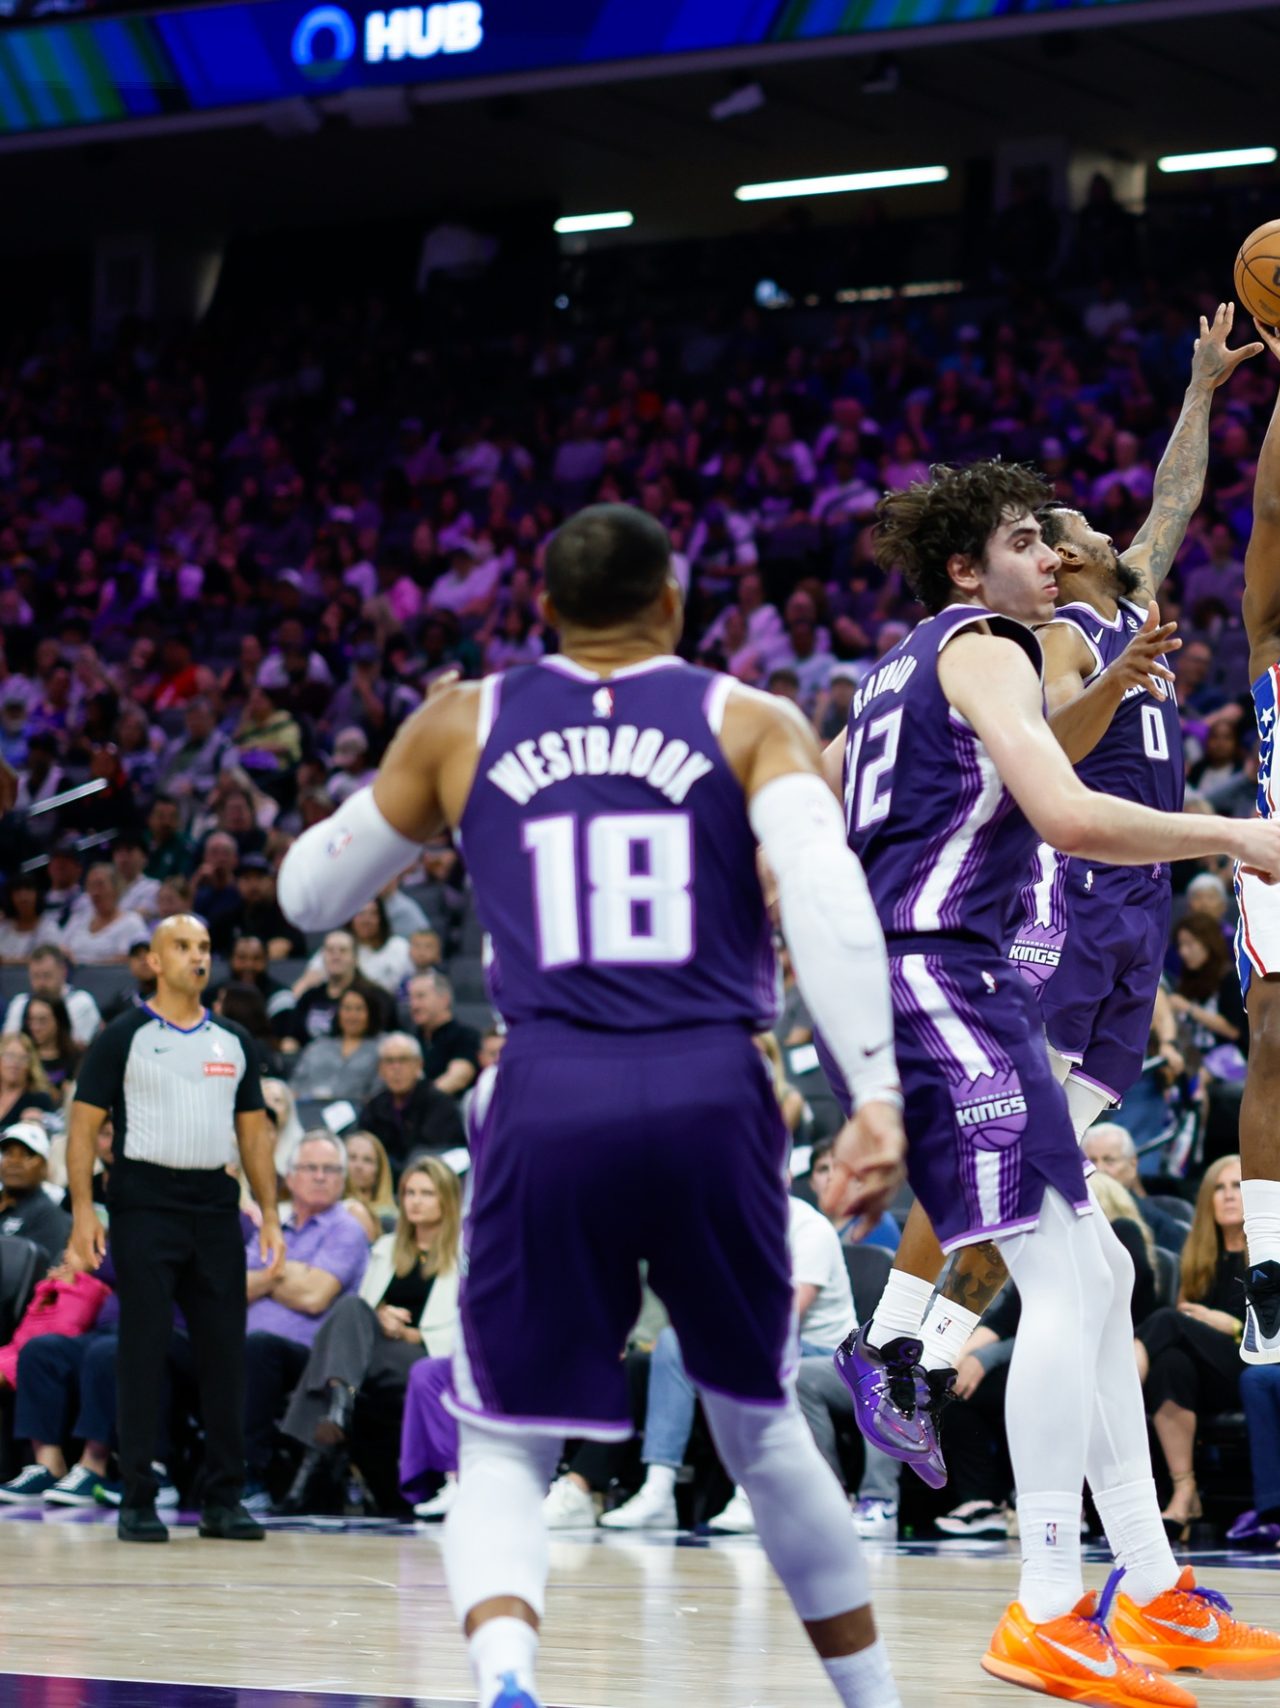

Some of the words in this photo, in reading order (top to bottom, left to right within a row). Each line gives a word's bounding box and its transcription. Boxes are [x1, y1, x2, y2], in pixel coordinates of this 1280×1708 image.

[364, 1, 482, 63] HUB
[1141, 705, 1169, 760] 0
[487, 724, 714, 805] WESTBROOK
[521, 811, 696, 971] 18
[1008, 945, 1061, 967] KINGS
[955, 1095, 1028, 1127] KINGS
